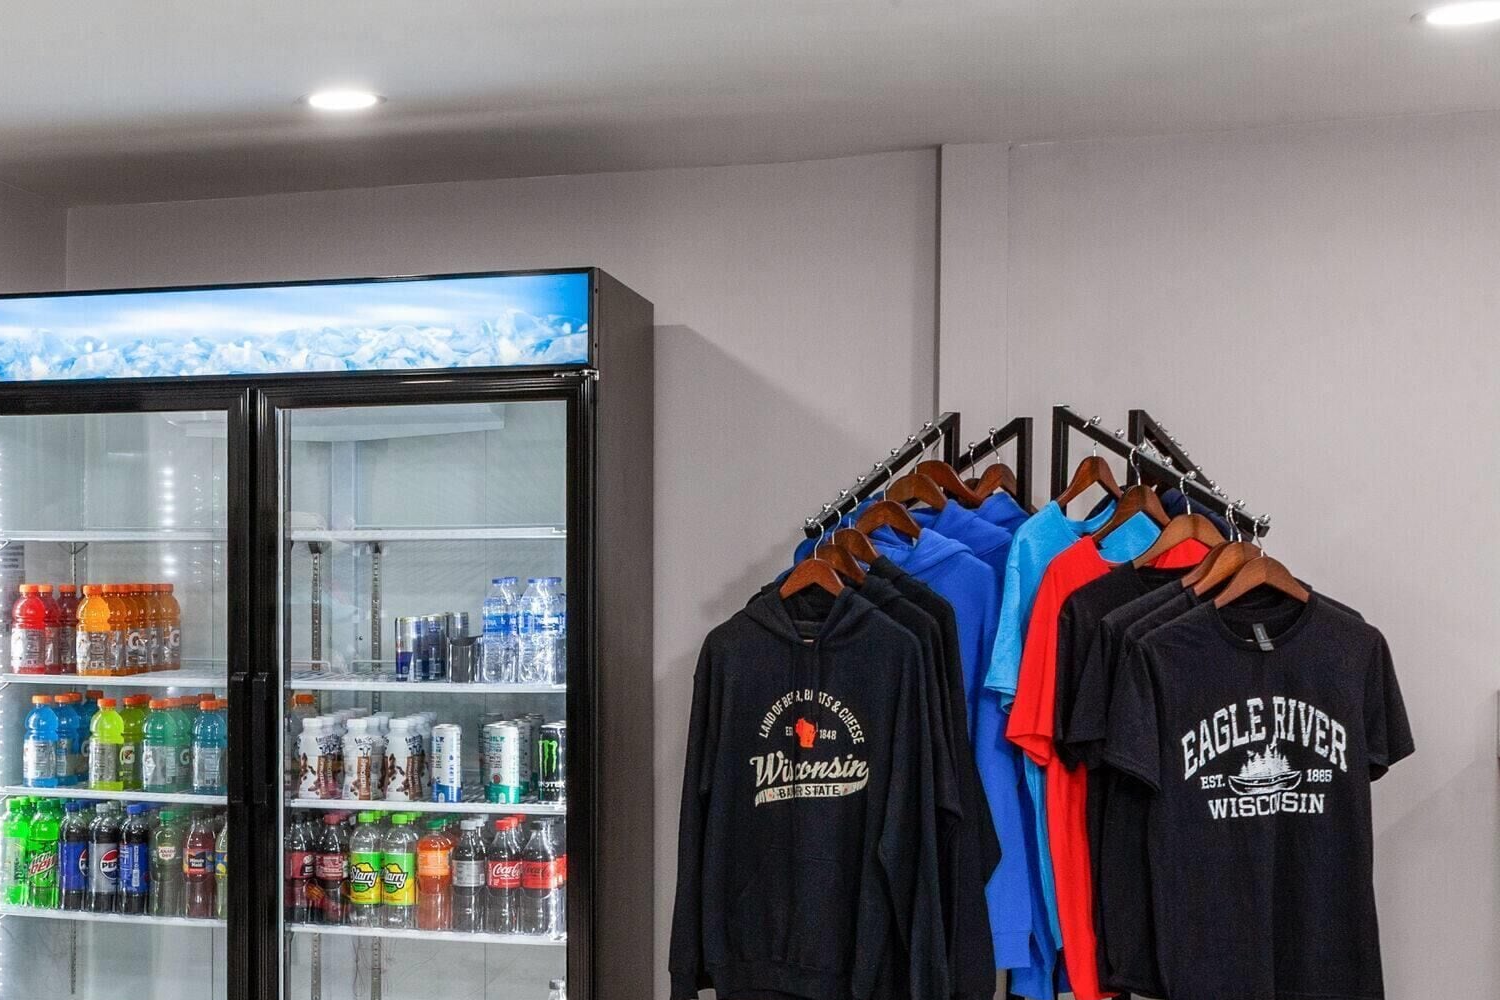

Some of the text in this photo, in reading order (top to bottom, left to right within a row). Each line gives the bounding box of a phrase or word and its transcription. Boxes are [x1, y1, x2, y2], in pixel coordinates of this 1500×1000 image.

[759, 689, 865, 745] LAND OF BER, BTS & CHEESE
[819, 729, 837, 740] 1848
[1181, 696, 1348, 781] EAGLE RIVER
[1201, 774, 1226, 789] EST.
[805, 785, 840, 796] STATE
[1208, 792, 1325, 820] WISCONSIN
[102, 862, 117, 870] PEP
